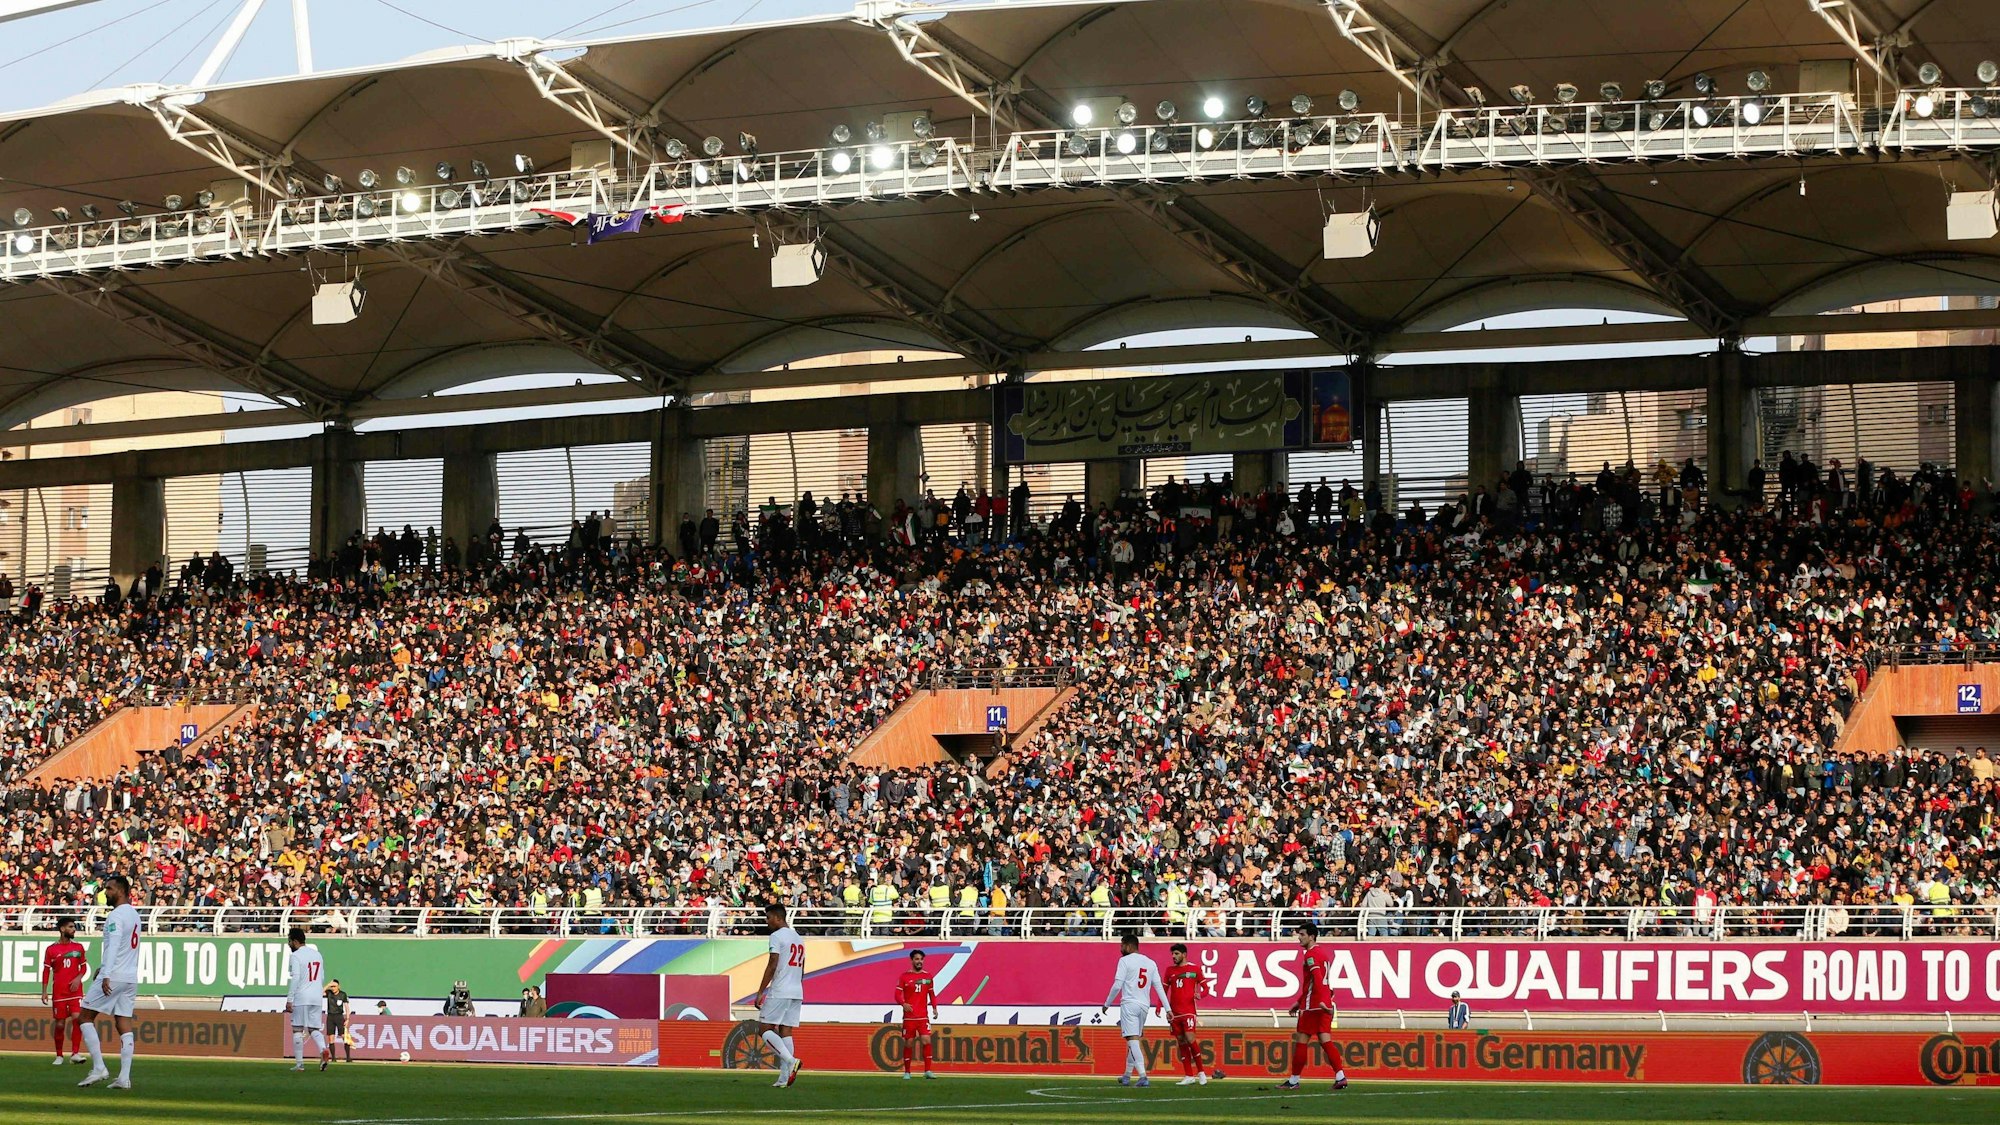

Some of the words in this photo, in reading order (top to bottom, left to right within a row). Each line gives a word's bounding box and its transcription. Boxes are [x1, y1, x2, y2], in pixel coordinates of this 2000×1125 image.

[592, 213, 627, 236] AFC
[130, 924, 138, 950] 6
[62, 958, 72, 968] 10
[183, 942, 217, 986] TO
[788, 943, 805, 967] 22
[307, 961, 320, 982] 17
[1137, 967, 1148, 989] 5
[1222, 949, 1412, 999] ASAN
[1424, 949, 1789, 1001] QUALIFIERS
[1803, 950, 1907, 1001] ROAD
[1921, 949, 1971, 1001] TO
[429, 1024, 614, 1054] QUALIFIERS
[618, 1028, 641, 1040] ROAD
[641, 1028, 652, 1040] TO
[618, 1040, 652, 1054] QATAR
[1435, 1035, 1466, 1069] in
[1476, 1035, 1644, 1078] Germany
